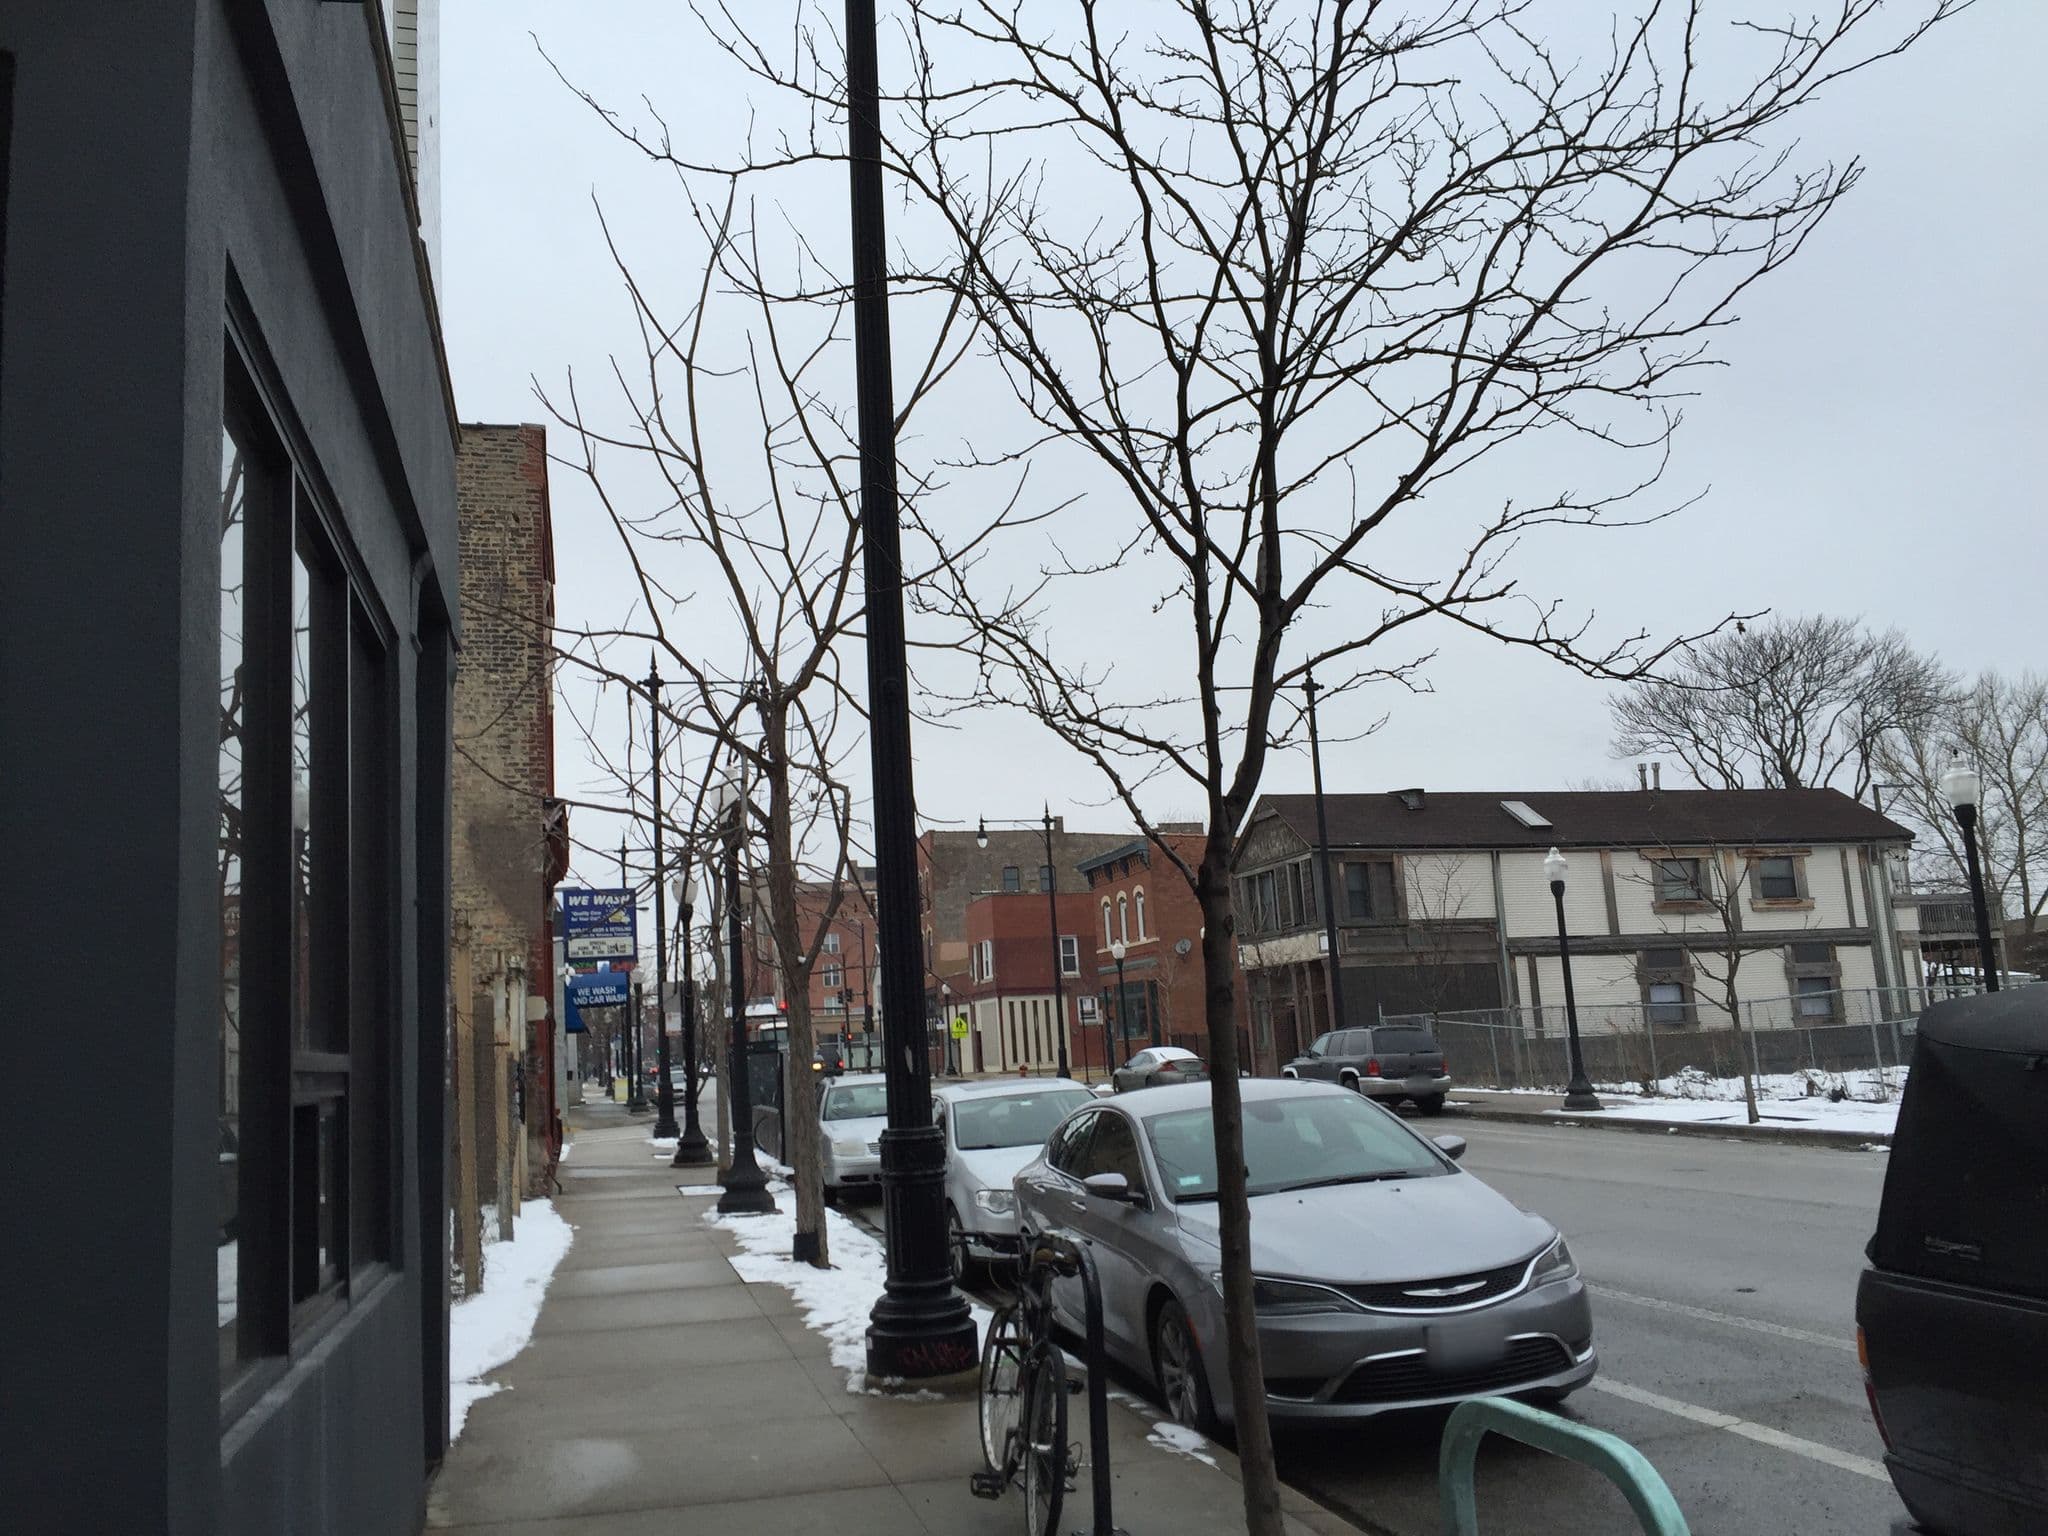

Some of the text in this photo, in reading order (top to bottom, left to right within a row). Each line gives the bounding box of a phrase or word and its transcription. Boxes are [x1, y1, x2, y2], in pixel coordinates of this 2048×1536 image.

[568, 894, 630, 906] WE WASH
[577, 986, 616, 996] WE WASH
[589, 995, 605, 1004] CAR
[605, 993, 627, 1002] WASH
